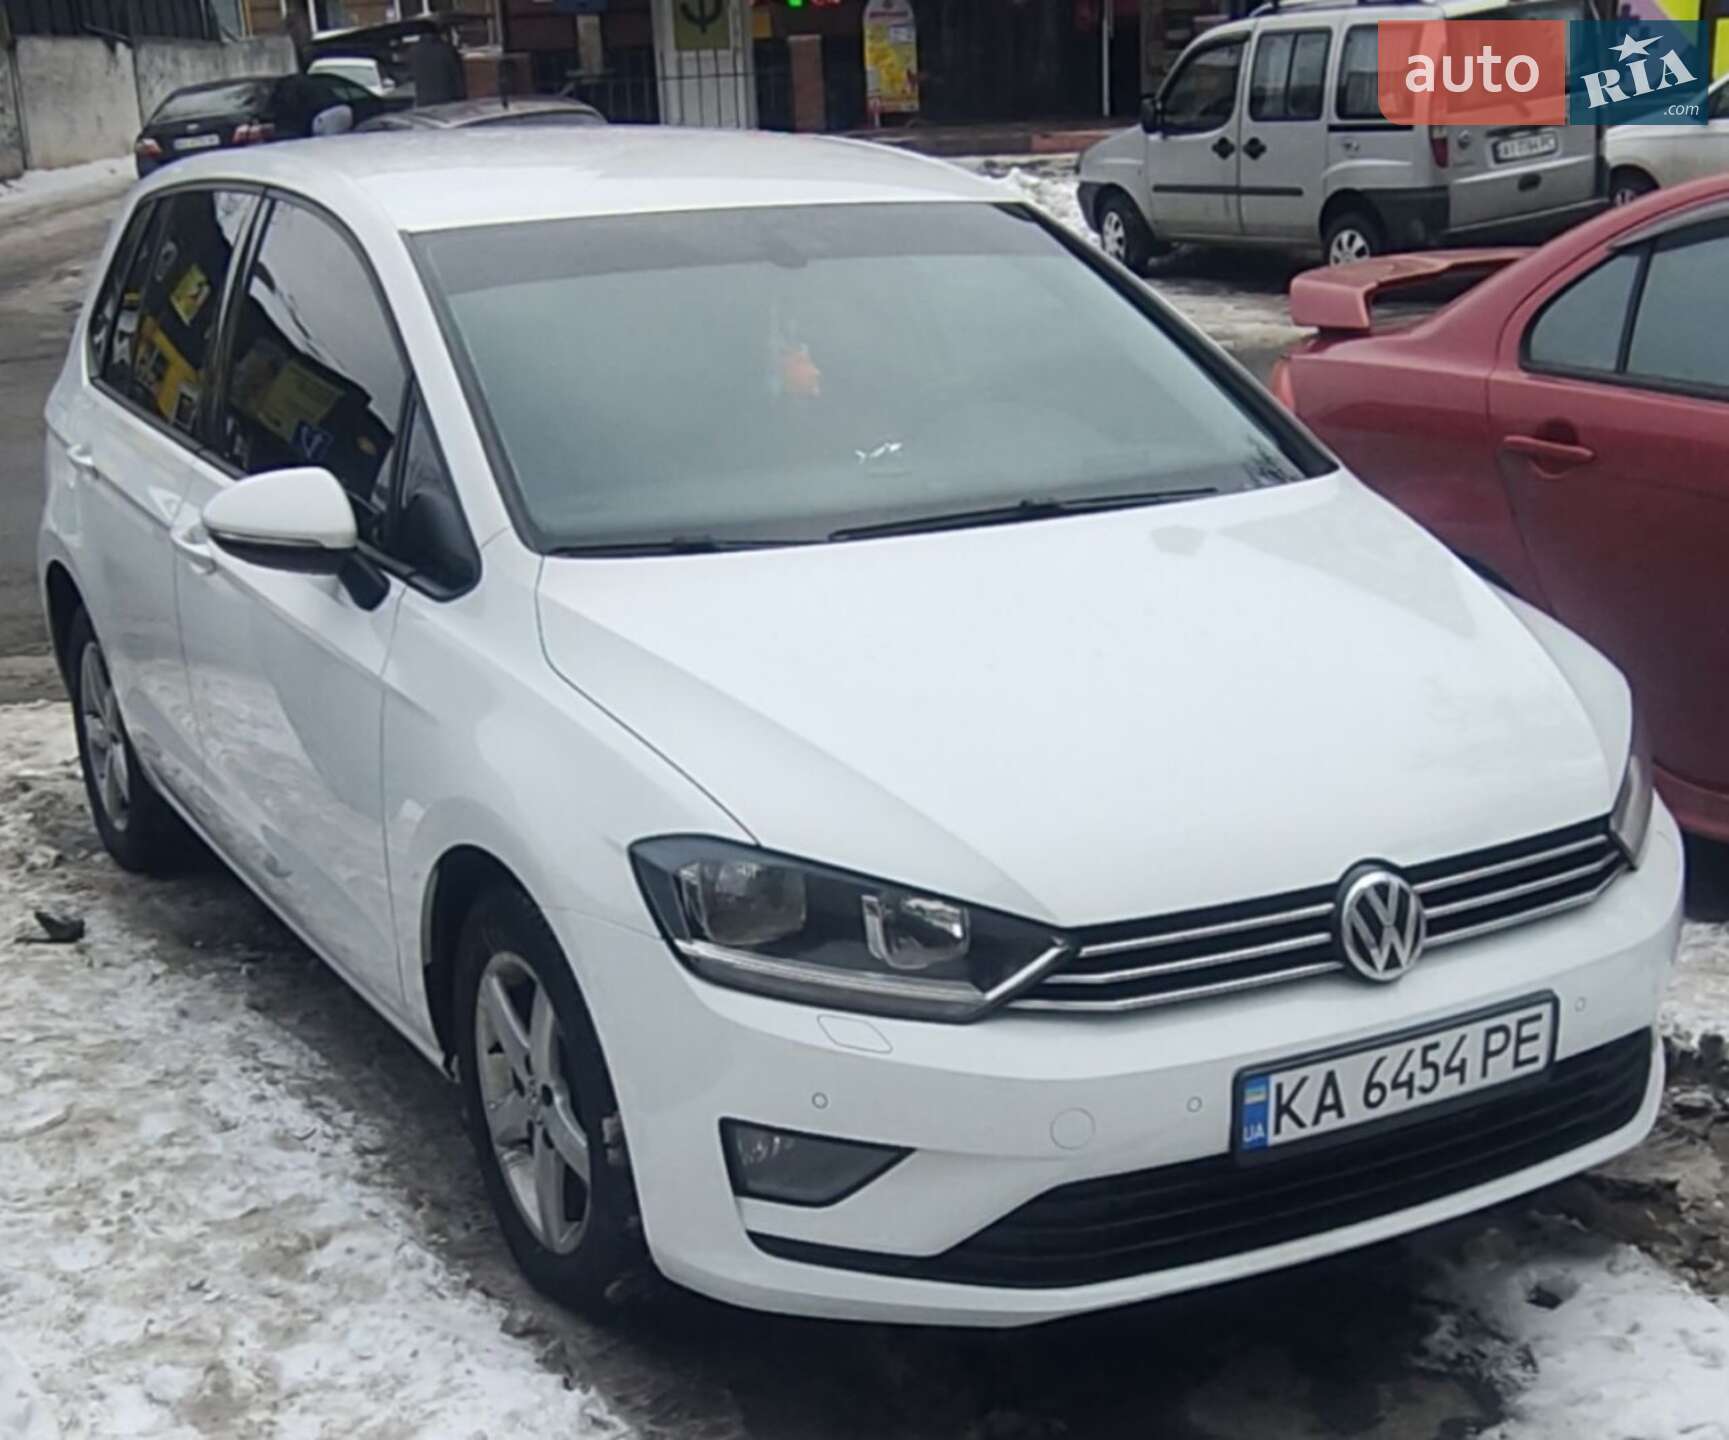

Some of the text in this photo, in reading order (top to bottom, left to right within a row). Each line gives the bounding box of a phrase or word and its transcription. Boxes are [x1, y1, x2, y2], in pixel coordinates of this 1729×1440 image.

[1272, 1012, 1544, 1136] KA 6454 PE
[1243, 1123, 1265, 1143] UA
